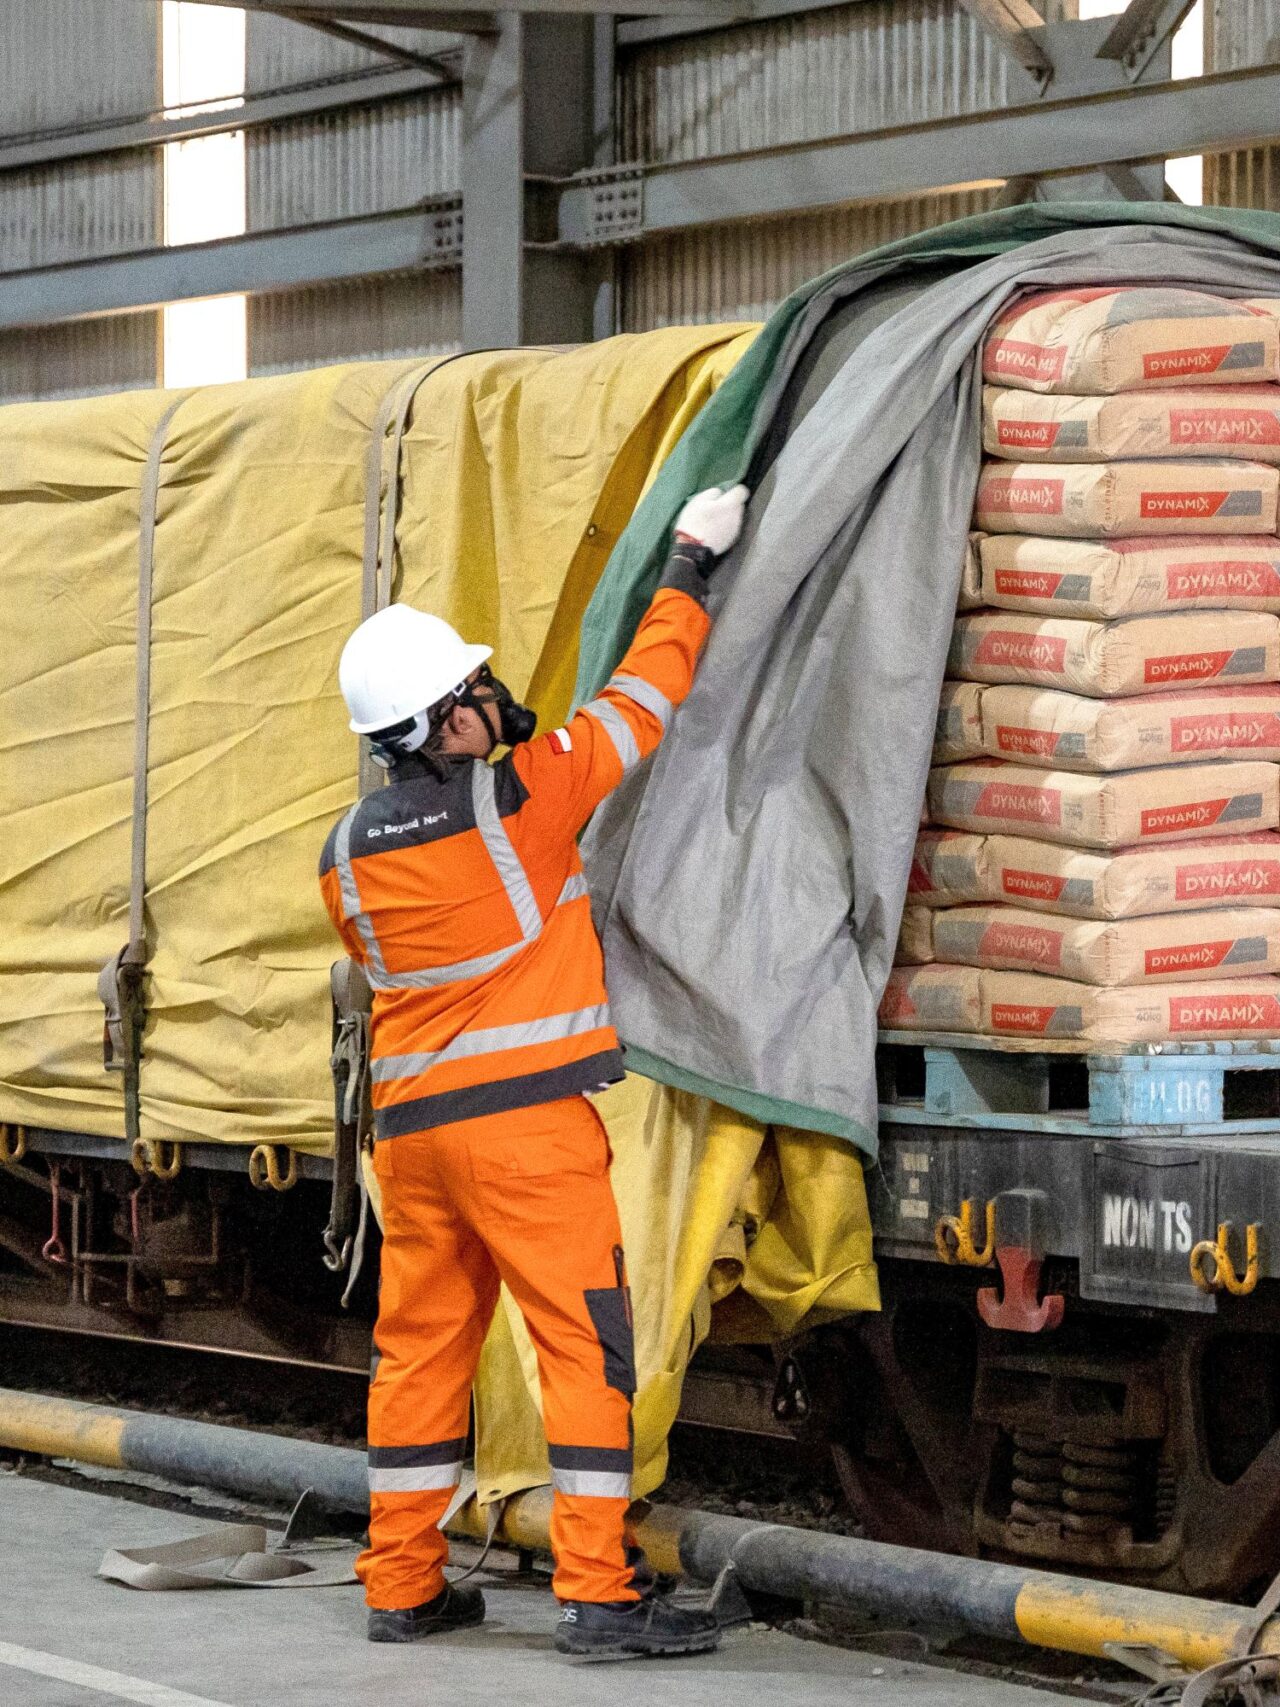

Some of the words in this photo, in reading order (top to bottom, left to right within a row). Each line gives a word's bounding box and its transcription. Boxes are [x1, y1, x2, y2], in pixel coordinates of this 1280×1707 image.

[1150, 353, 1212, 372] DYNAMIX
[1001, 427, 1049, 441] DYNAMIX
[1180, 418, 1264, 438] DYNAMIX
[994, 487, 1055, 508] DYNAMIX
[1147, 497, 1210, 513] DYNAMIX
[1000, 577, 1049, 592] DYNAMIX
[1177, 571, 1262, 591] DYNAMIX
[992, 641, 1055, 663] DYNAMIX
[1151, 659, 1214, 676] DYNAMIX
[1001, 733, 1050, 750] DYNAMIX
[1181, 721, 1266, 743] DYNAMIX
[991, 794, 1052, 816] DYNAMIX
[1147, 808, 1211, 827] DYNAMIX
[367, 828, 381, 838] Go
[384, 818, 419, 834] Beyond
[1006, 876, 1054, 895] DYNAMIX
[1185, 868, 1270, 891] DYNAMIX
[1151, 948, 1215, 967] DYNAMIX
[995, 1012, 1042, 1025] DYNAMIX
[1180, 1004, 1265, 1024] DYNAMIX
[1103, 1194, 1155, 1249] NON
[1161, 1200, 1192, 1253] TS
